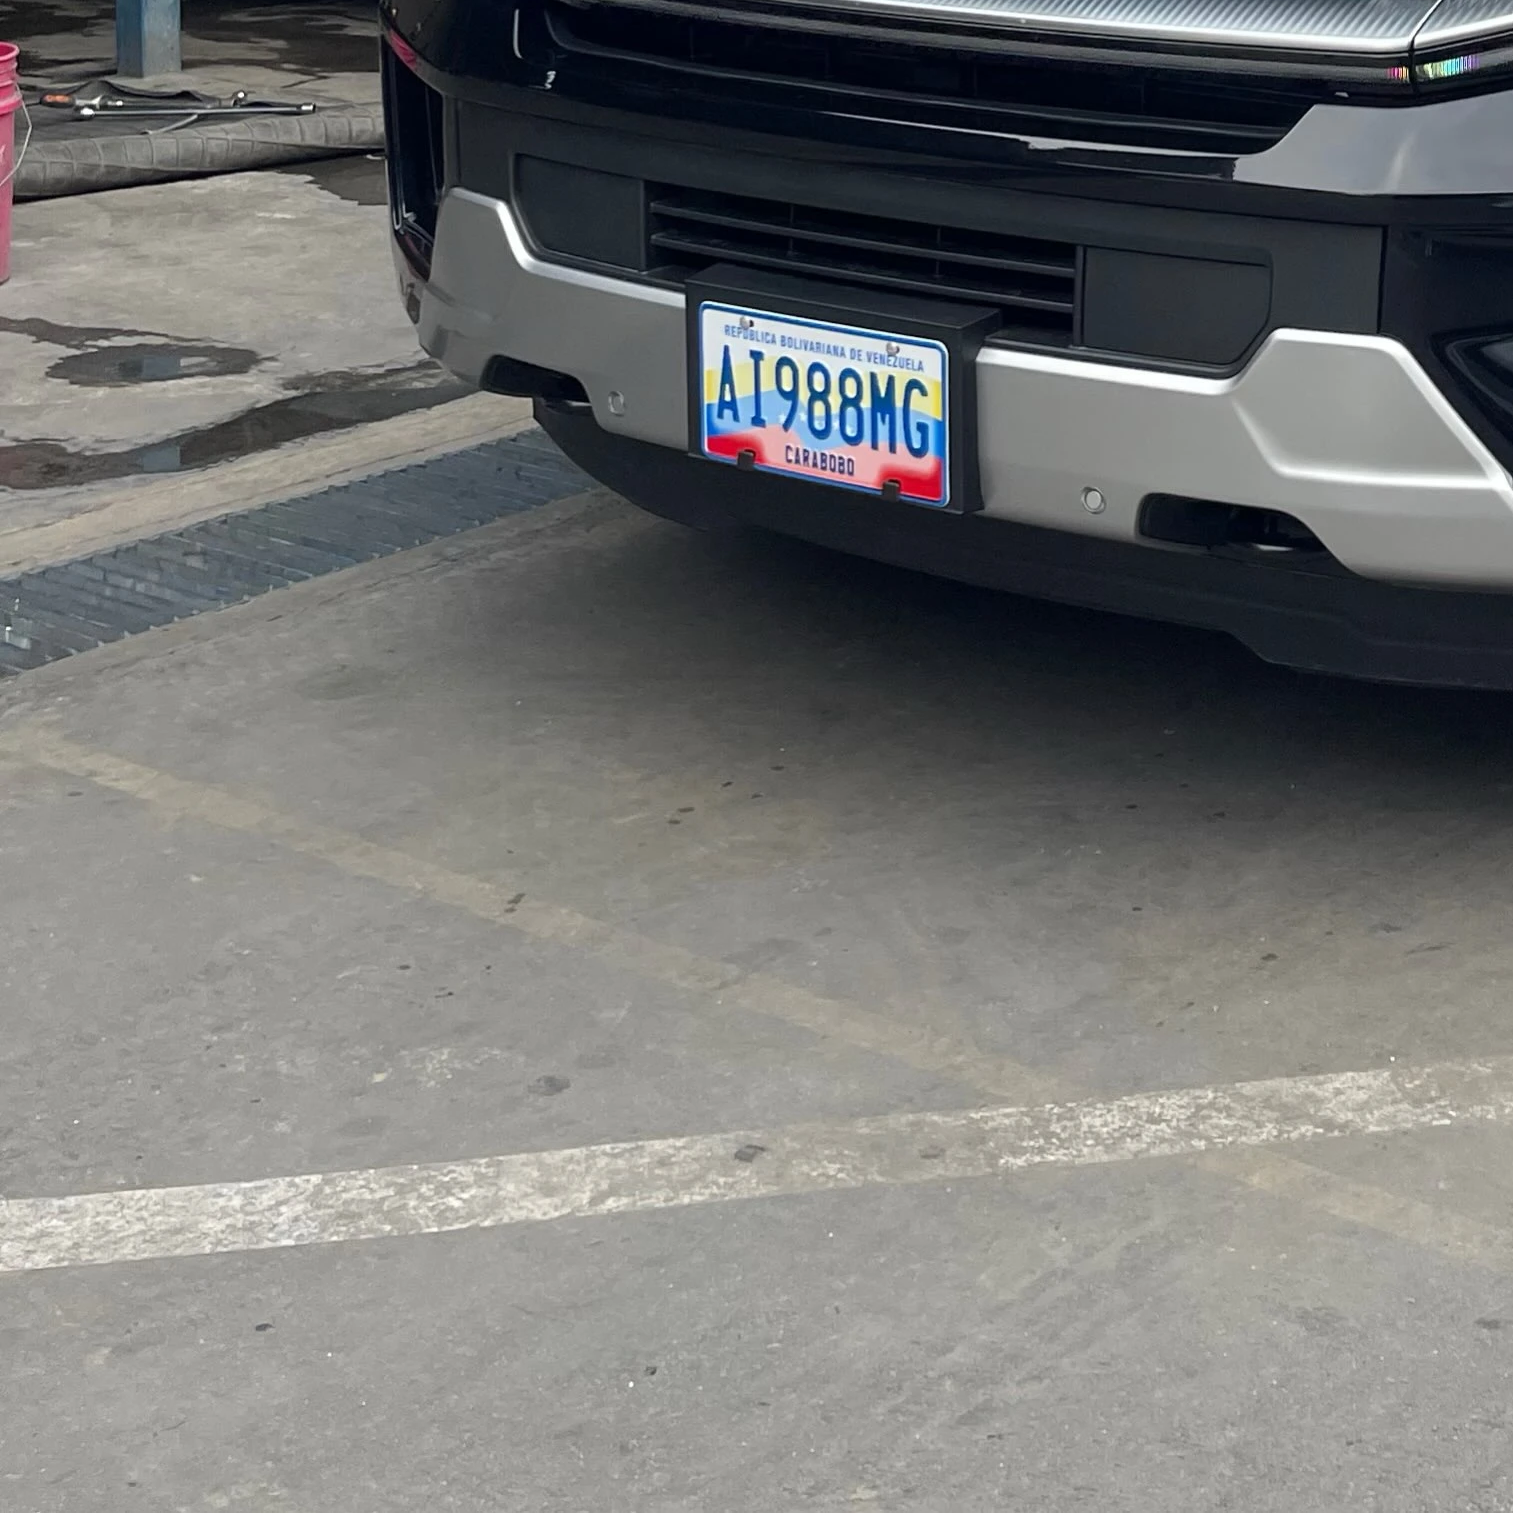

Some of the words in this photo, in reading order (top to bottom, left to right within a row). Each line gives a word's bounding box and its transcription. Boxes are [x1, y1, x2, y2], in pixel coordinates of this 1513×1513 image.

[780, 335, 846, 358] BOLIVARIANA
[850, 348, 863, 362] DE
[866, 350, 924, 372] VENEZUELA
[717, 344, 930, 458] AI988MG
[785, 444, 854, 476] CARABOBO
